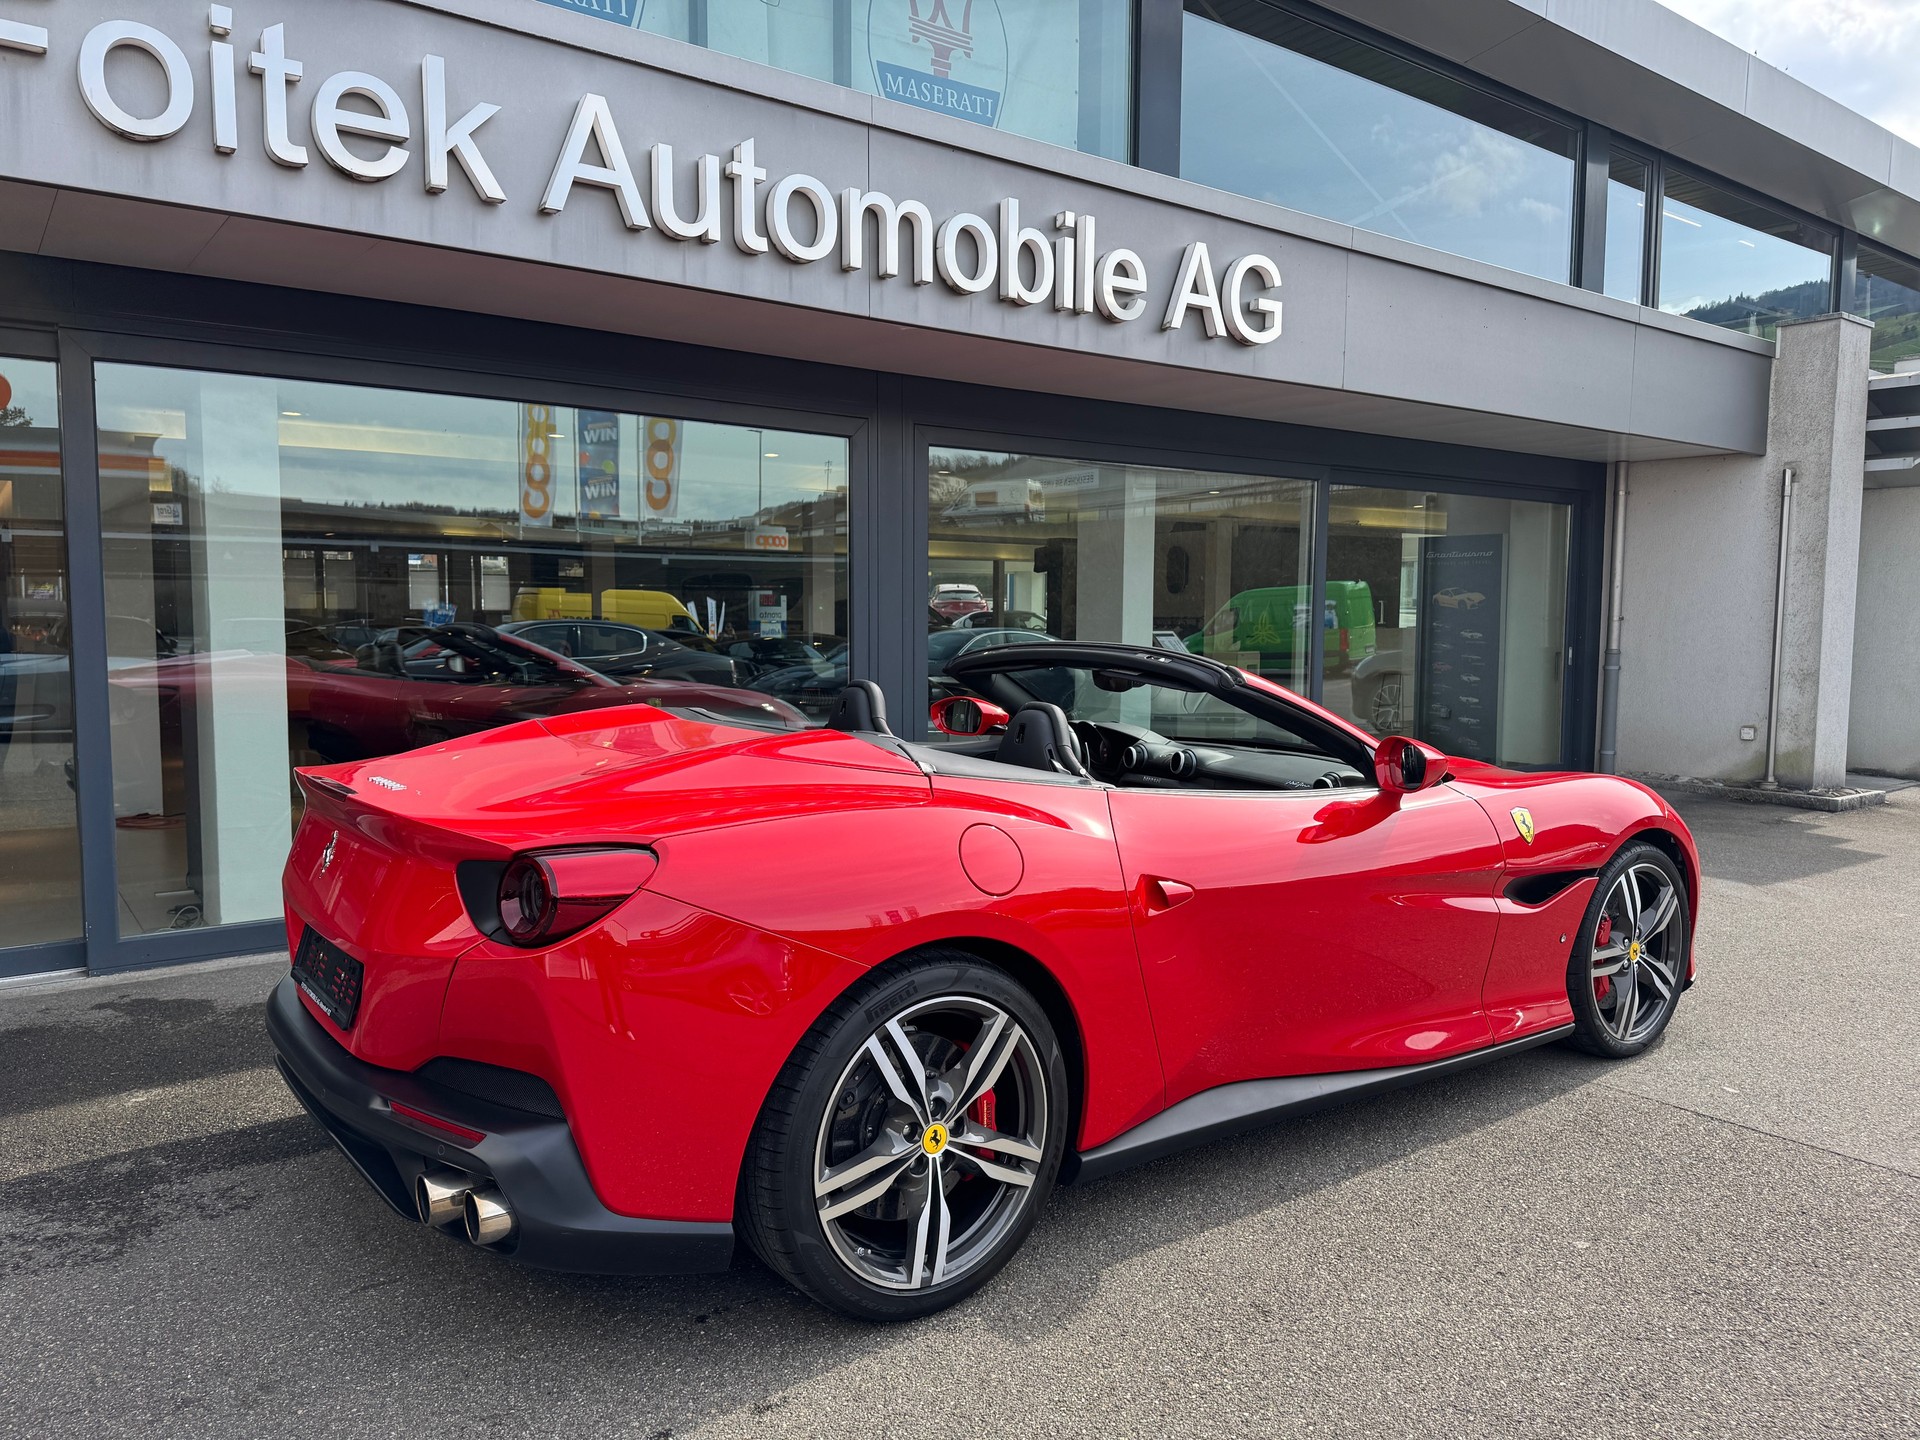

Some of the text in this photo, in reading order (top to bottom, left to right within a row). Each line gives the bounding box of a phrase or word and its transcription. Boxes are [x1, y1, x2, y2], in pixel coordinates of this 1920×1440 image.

[885, 73, 993, 118] MASERATI
[0, 4, 1283, 346] oitek Automobile AG
[584, 427, 617, 444] WIN
[645, 418, 676, 511] coo
[585, 482, 617, 500] WIN
[864, 980, 919, 1024] PIRELLI
